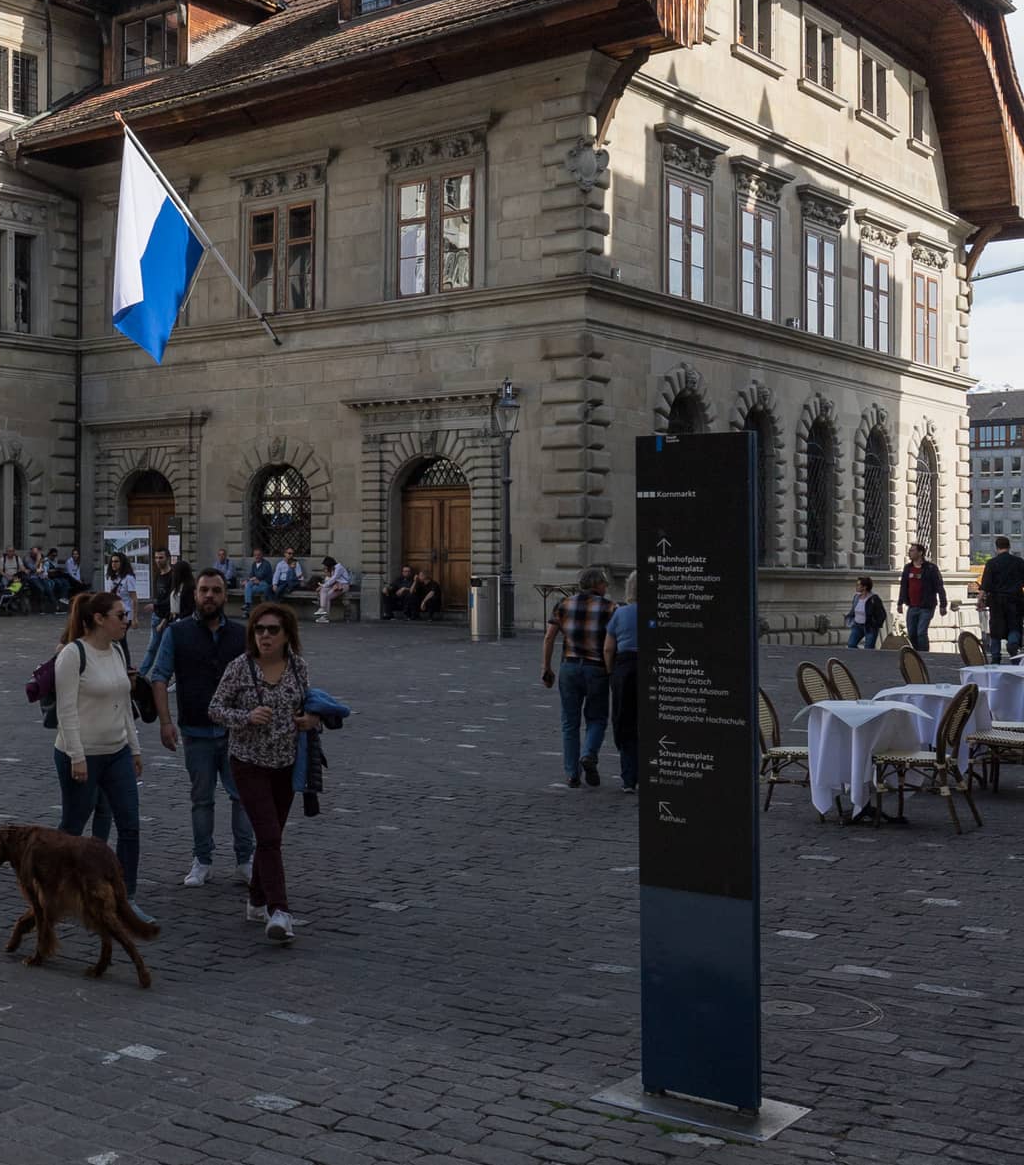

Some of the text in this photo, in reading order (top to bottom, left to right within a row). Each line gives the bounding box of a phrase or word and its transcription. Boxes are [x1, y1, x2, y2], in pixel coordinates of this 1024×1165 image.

[657, 556, 707, 564] Bahnhofplatz
[657, 565, 704, 573] Theaterplatz
[658, 657, 698, 666] Weinmarkt
[658, 667, 705, 676] Theaterplatz
